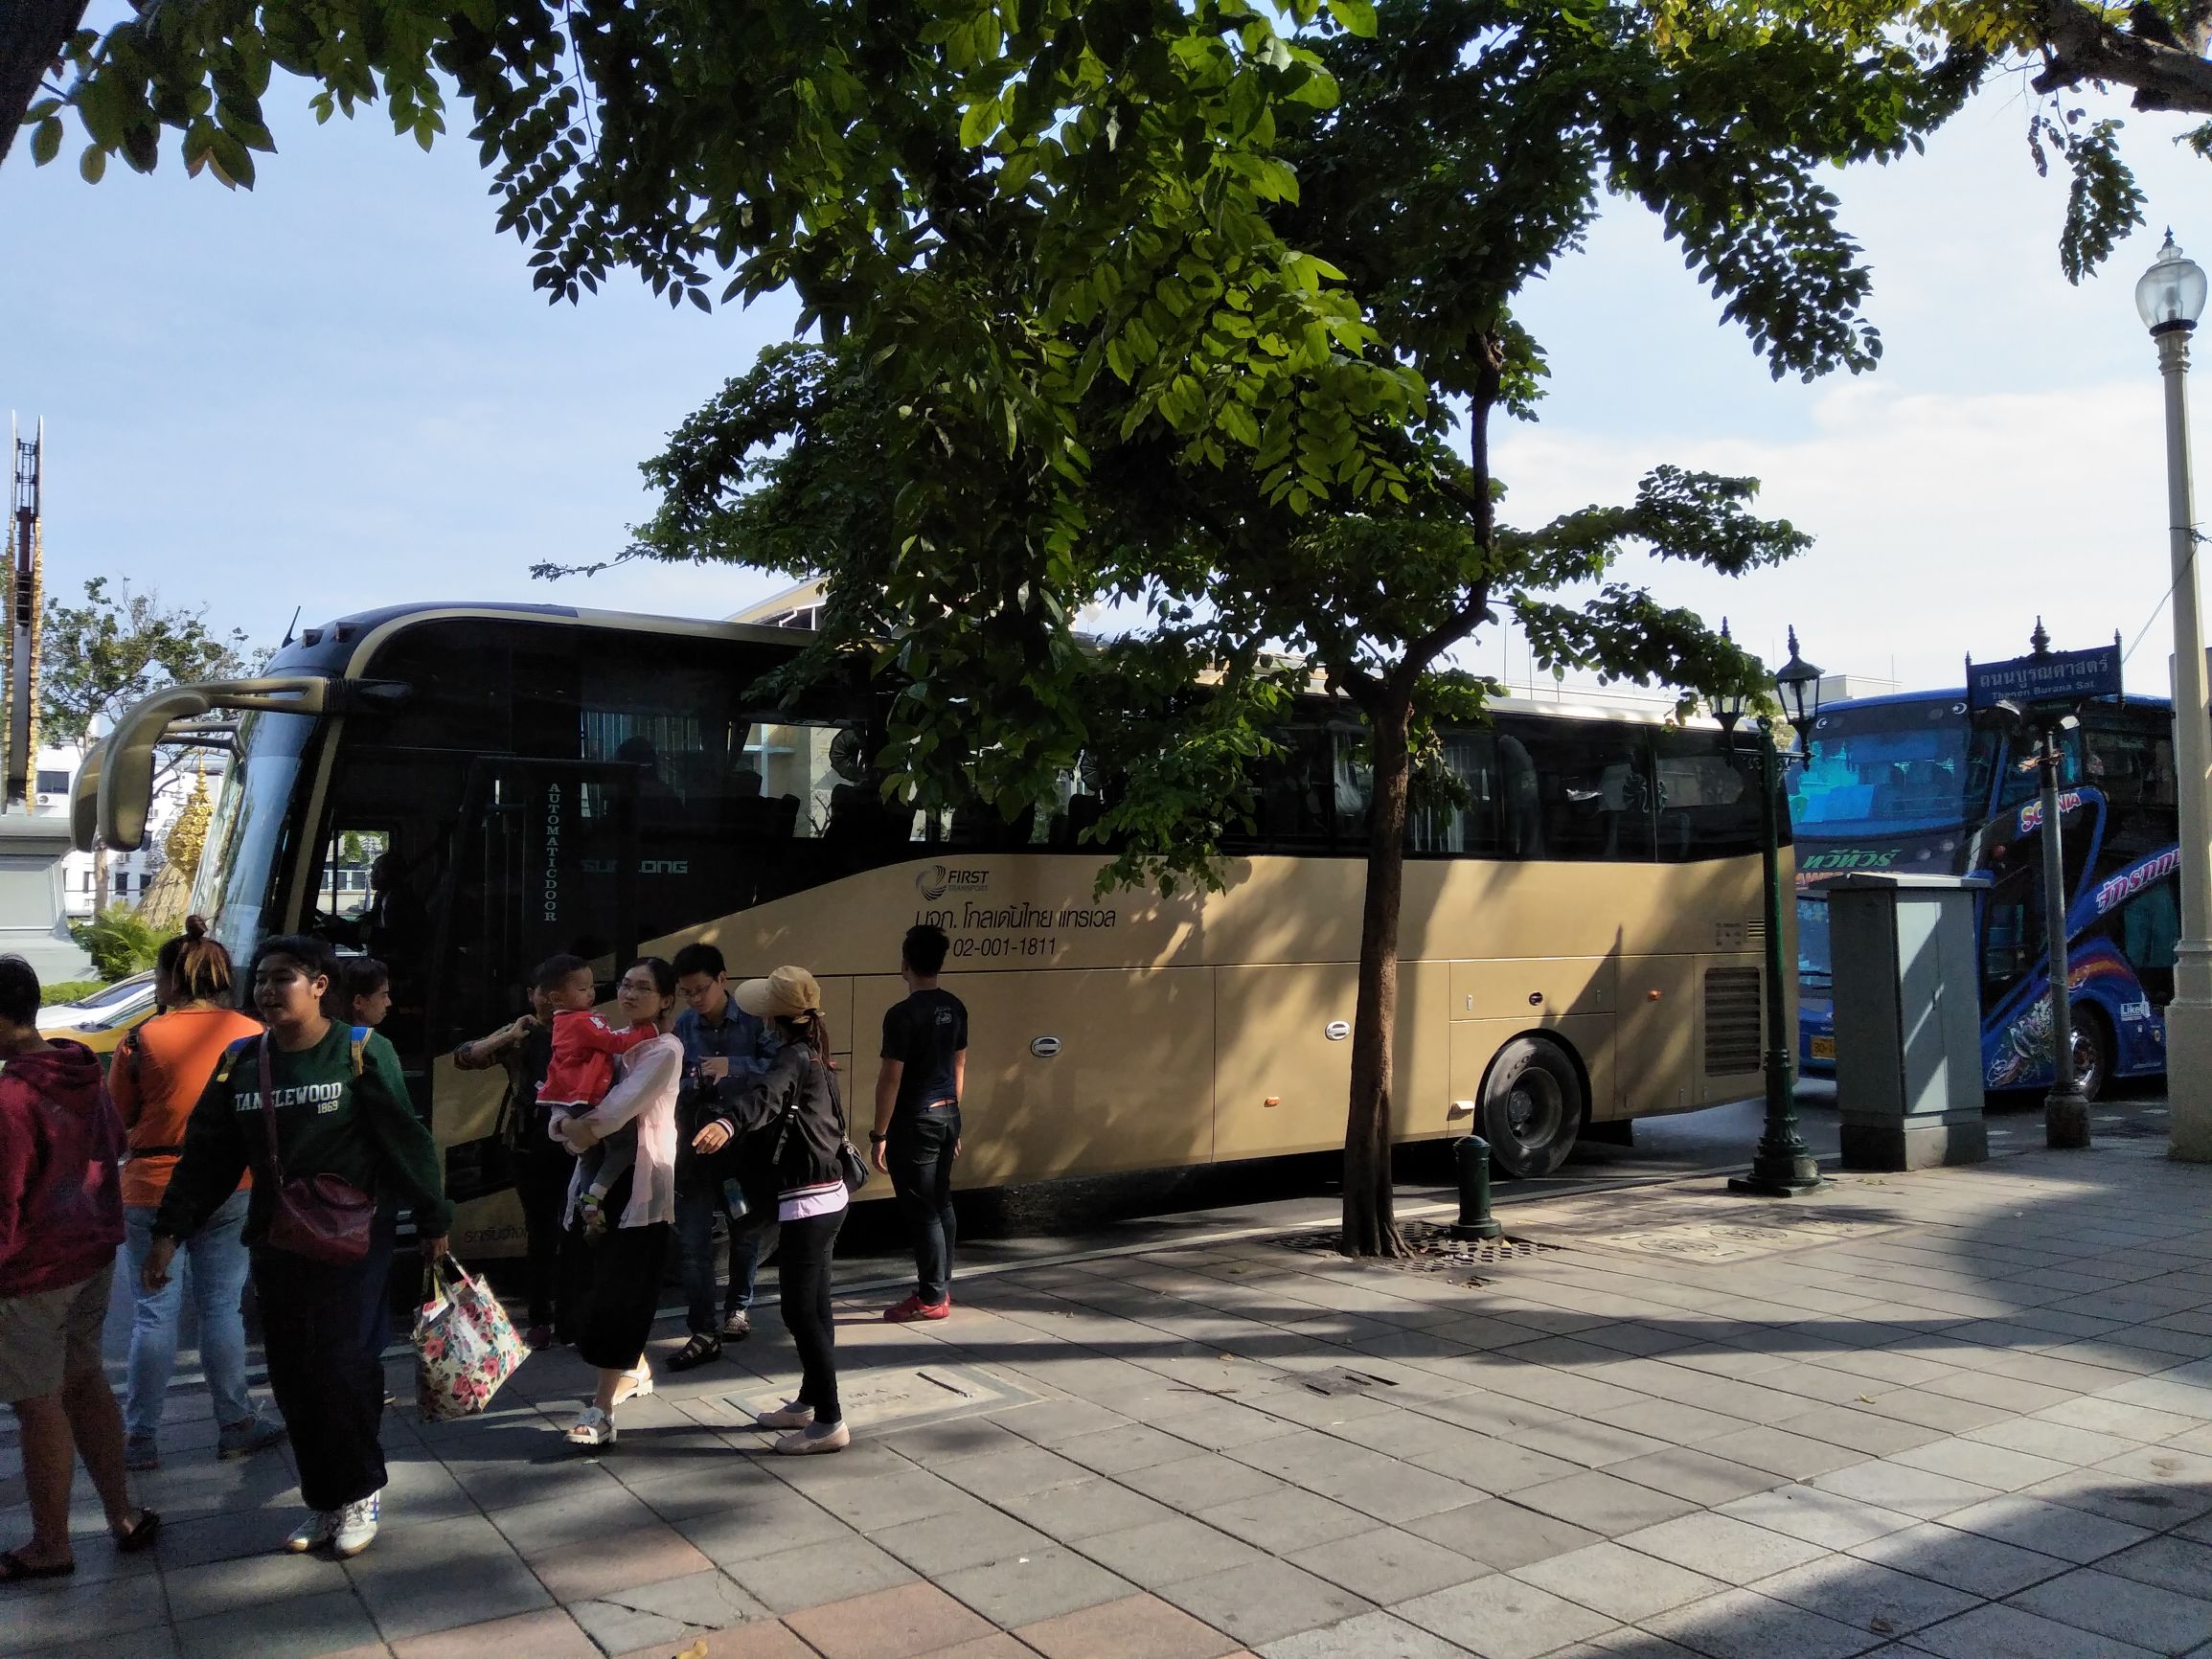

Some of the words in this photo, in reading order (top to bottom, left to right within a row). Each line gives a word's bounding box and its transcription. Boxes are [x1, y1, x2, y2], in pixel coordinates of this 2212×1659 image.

[1992, 689, 2030, 701] Thanon
[2034, 683, 2072, 695] Burana
[2076, 680, 2095, 691] Sat
[948, 870, 990, 883] FIRST
[963, 901, 1053, 928] โกลเด้นไทย
[1058, 909, 1116, 928] แทรเวล
[953, 937, 1056, 957] 02-001-1811
[235, 1081, 342, 1112] TANLEWOOD
[317, 1100, 338, 1115] 1869
